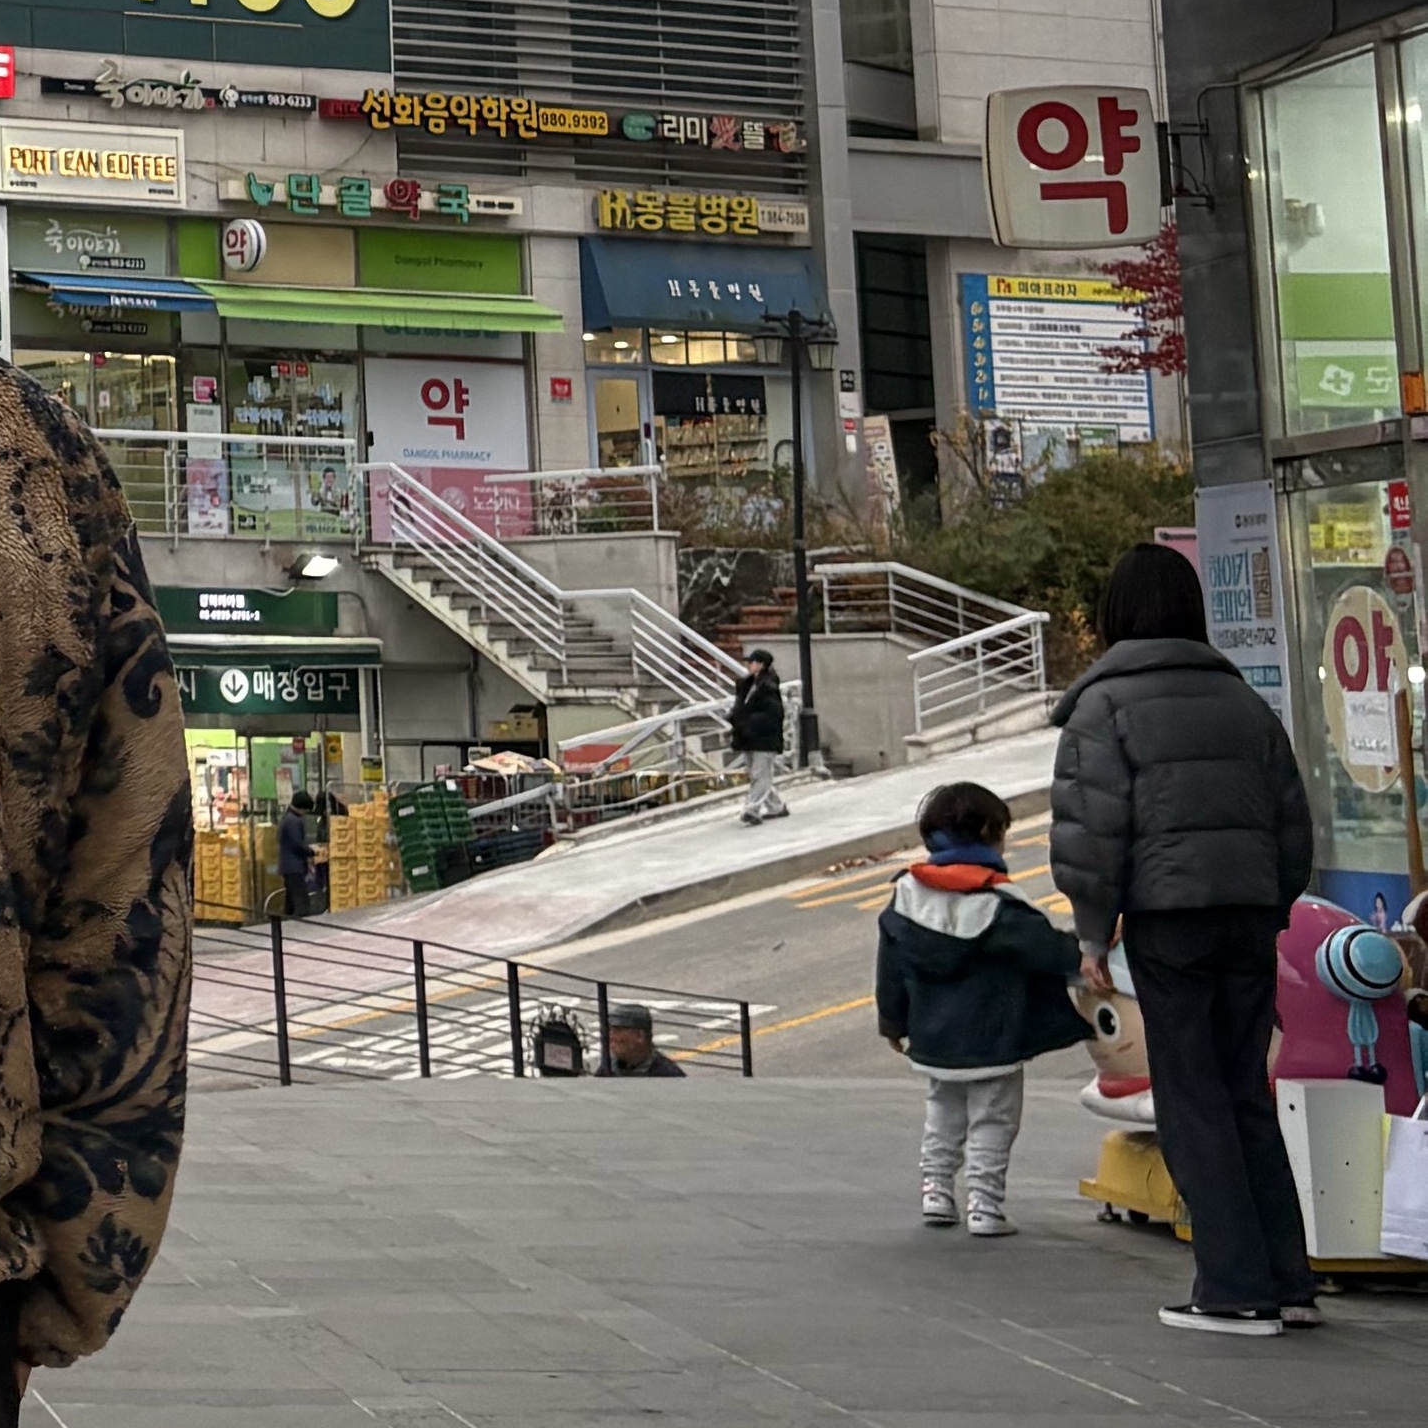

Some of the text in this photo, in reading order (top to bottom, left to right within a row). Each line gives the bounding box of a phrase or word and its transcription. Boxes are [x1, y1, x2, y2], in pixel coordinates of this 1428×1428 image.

[360, 87, 538, 140] 선화음악학원
[9, 146, 57, 174] PORT
[106, 152, 178, 181] COFFEE
[1016, 96, 1142, 235] 약
[286, 172, 471, 225] 단골약국
[420, 377, 470, 441] 약
[252, 670, 351, 703] 매장입구
